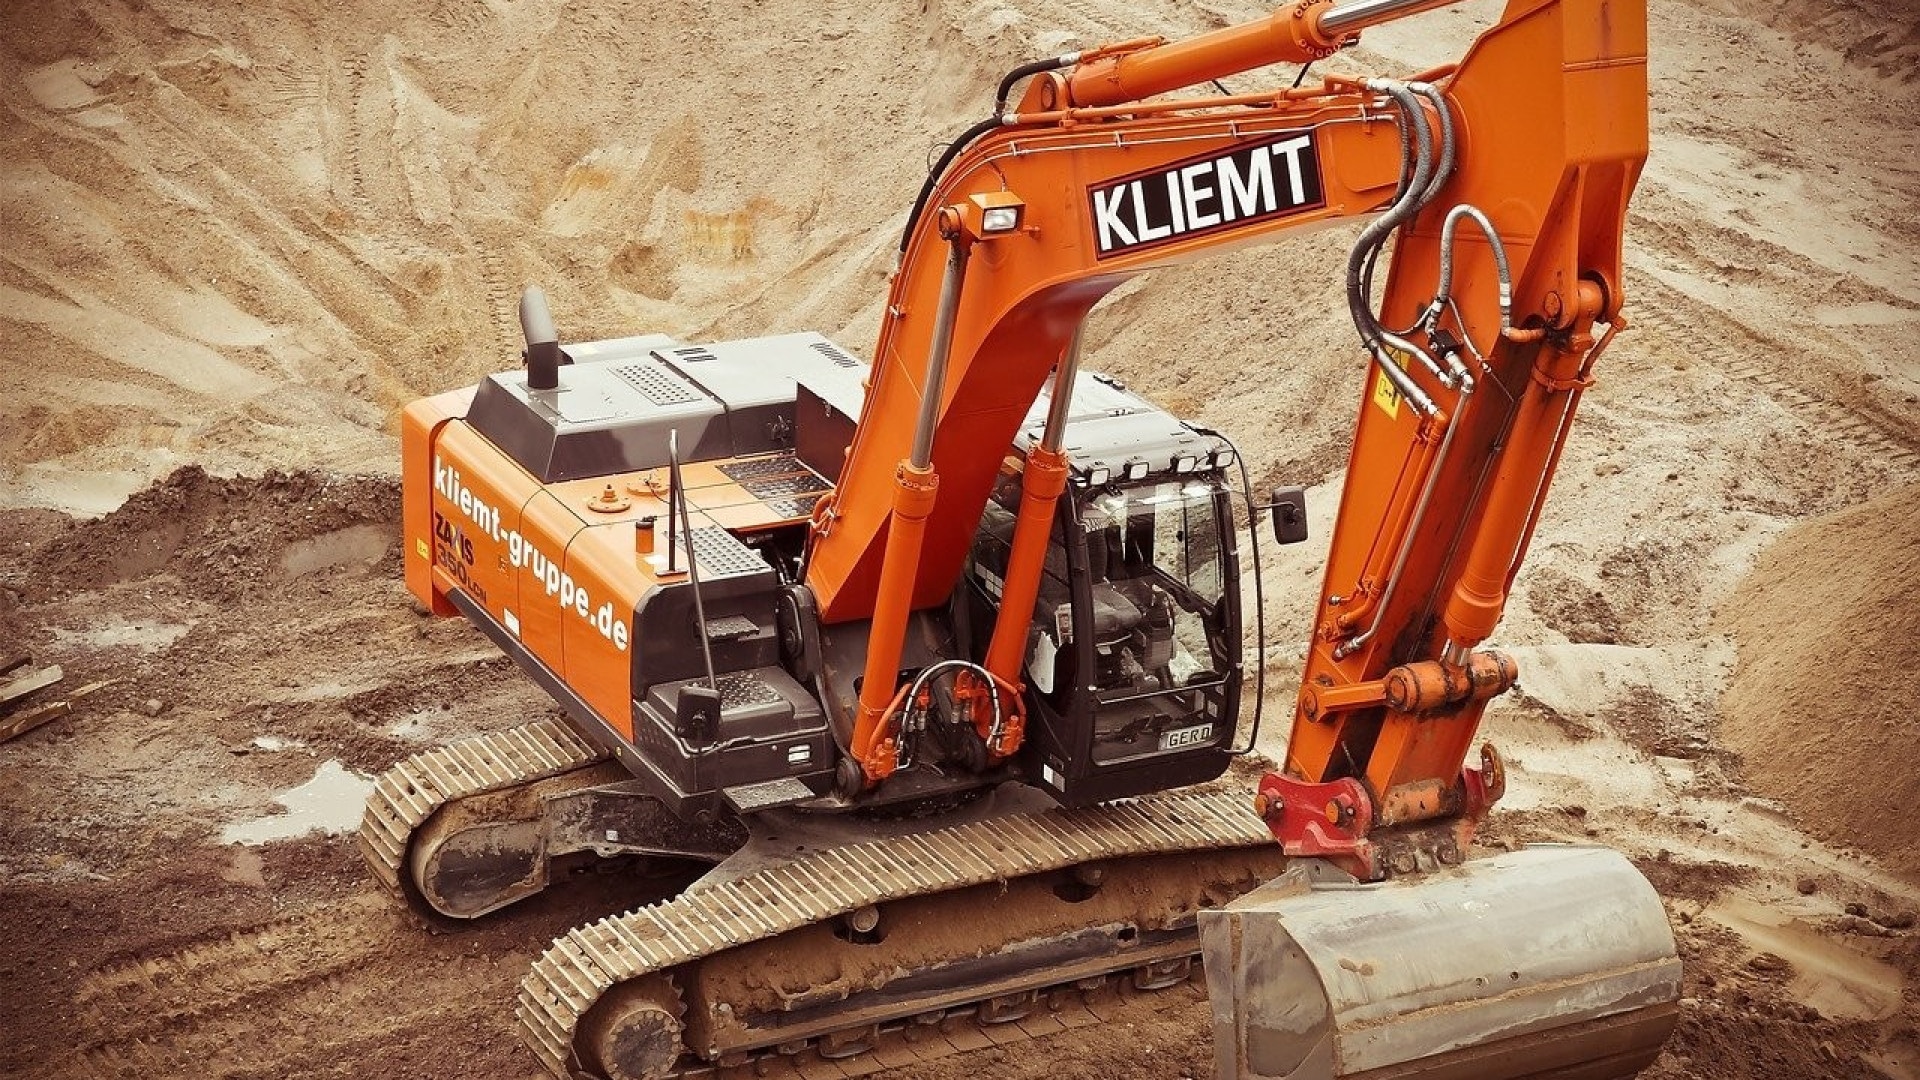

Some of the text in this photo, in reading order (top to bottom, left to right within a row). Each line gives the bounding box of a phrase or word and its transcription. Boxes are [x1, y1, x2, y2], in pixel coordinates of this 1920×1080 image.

[1094, 134, 1311, 251] KLIEMT
[434, 511, 475, 566] ZAXIS
[434, 456, 628, 650] kliemt-gruppe.de
[1169, 727, 1210, 746] GERD
